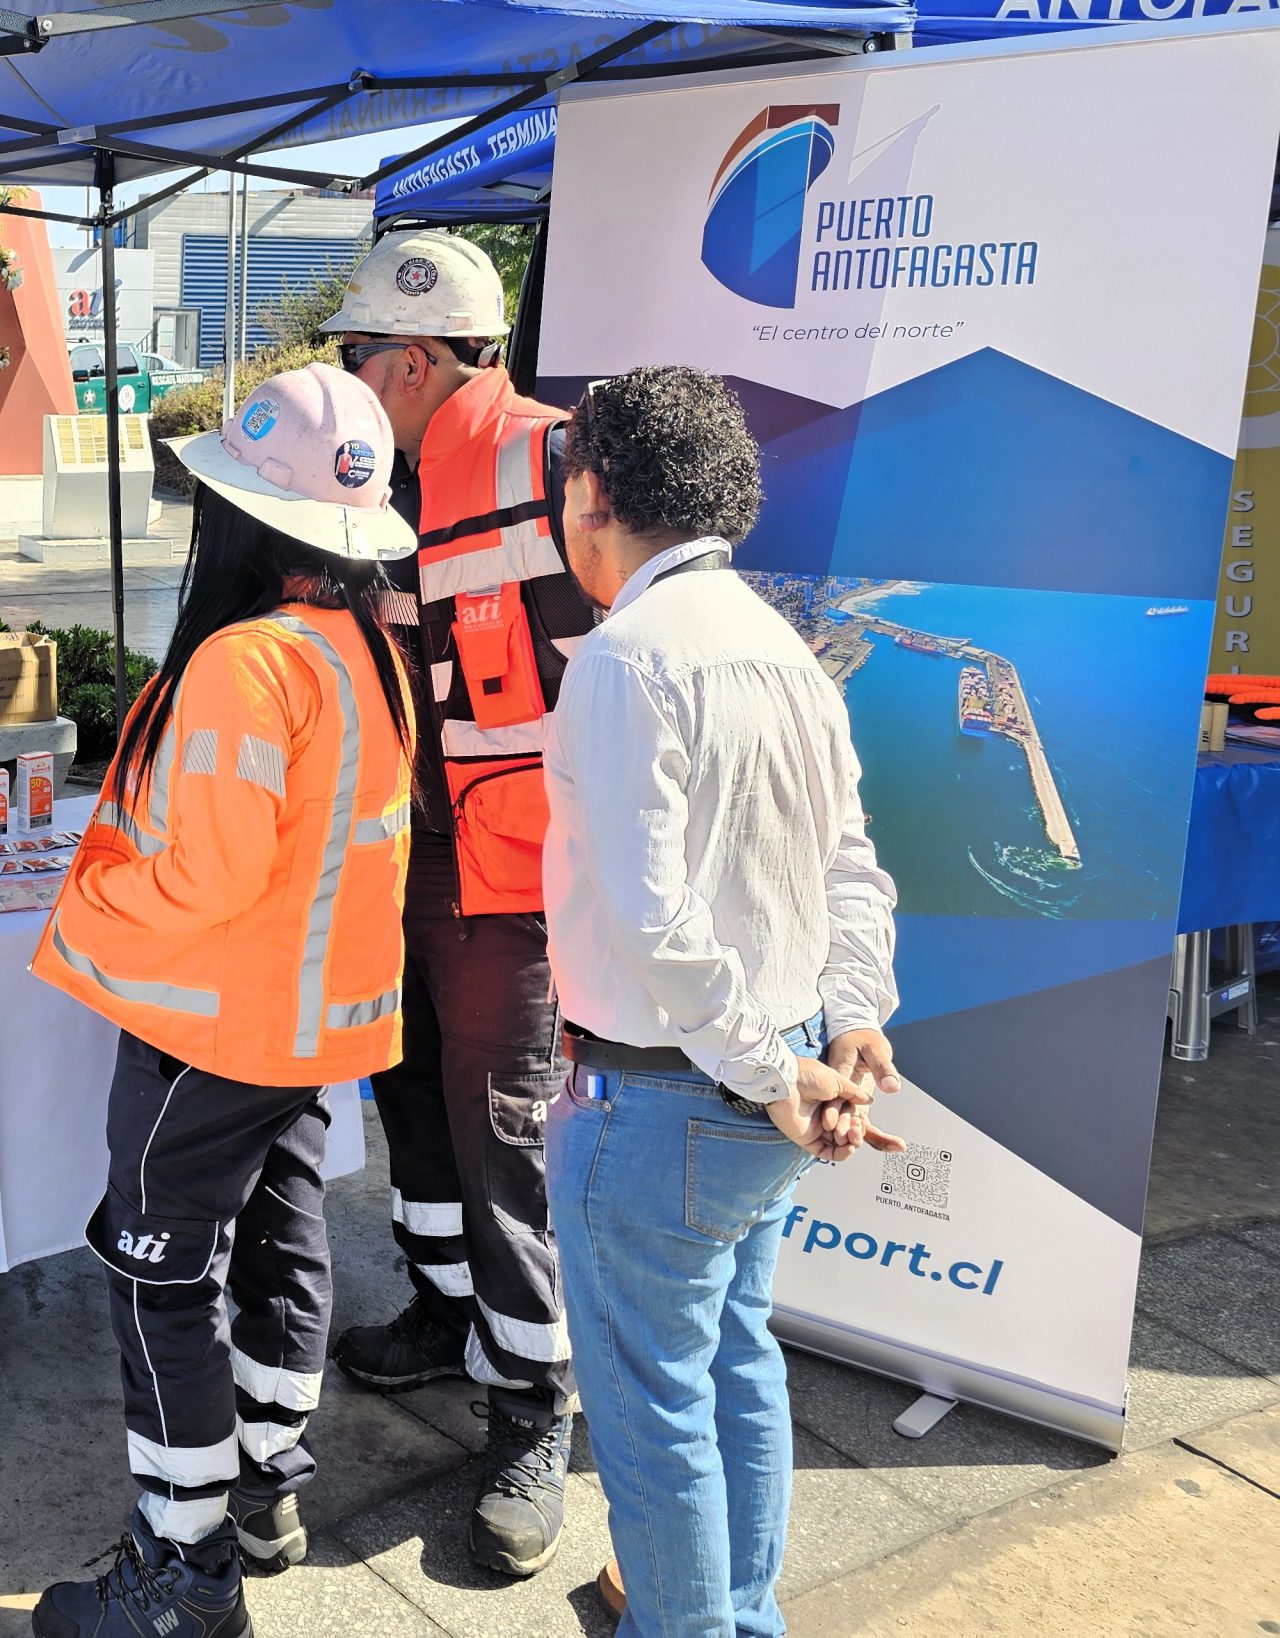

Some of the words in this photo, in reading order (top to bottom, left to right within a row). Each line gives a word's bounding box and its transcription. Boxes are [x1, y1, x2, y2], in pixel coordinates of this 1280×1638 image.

[392, 145, 480, 198] ANTOFAGASTA
[815, 194, 934, 243] PUERTO
[811, 241, 1038, 291] ANTOFAGASTA
[69, 279, 123, 317] at
[782, 325, 849, 341] centro
[854, 321, 888, 339] del
[892, 321, 965, 339] norte”
[462, 595, 501, 625] ati
[875, 1195, 950, 1221] PUERTO_ANTOFAGASTA
[117, 1230, 171, 1263] ati
[153, 1607, 180, 1637] HW
